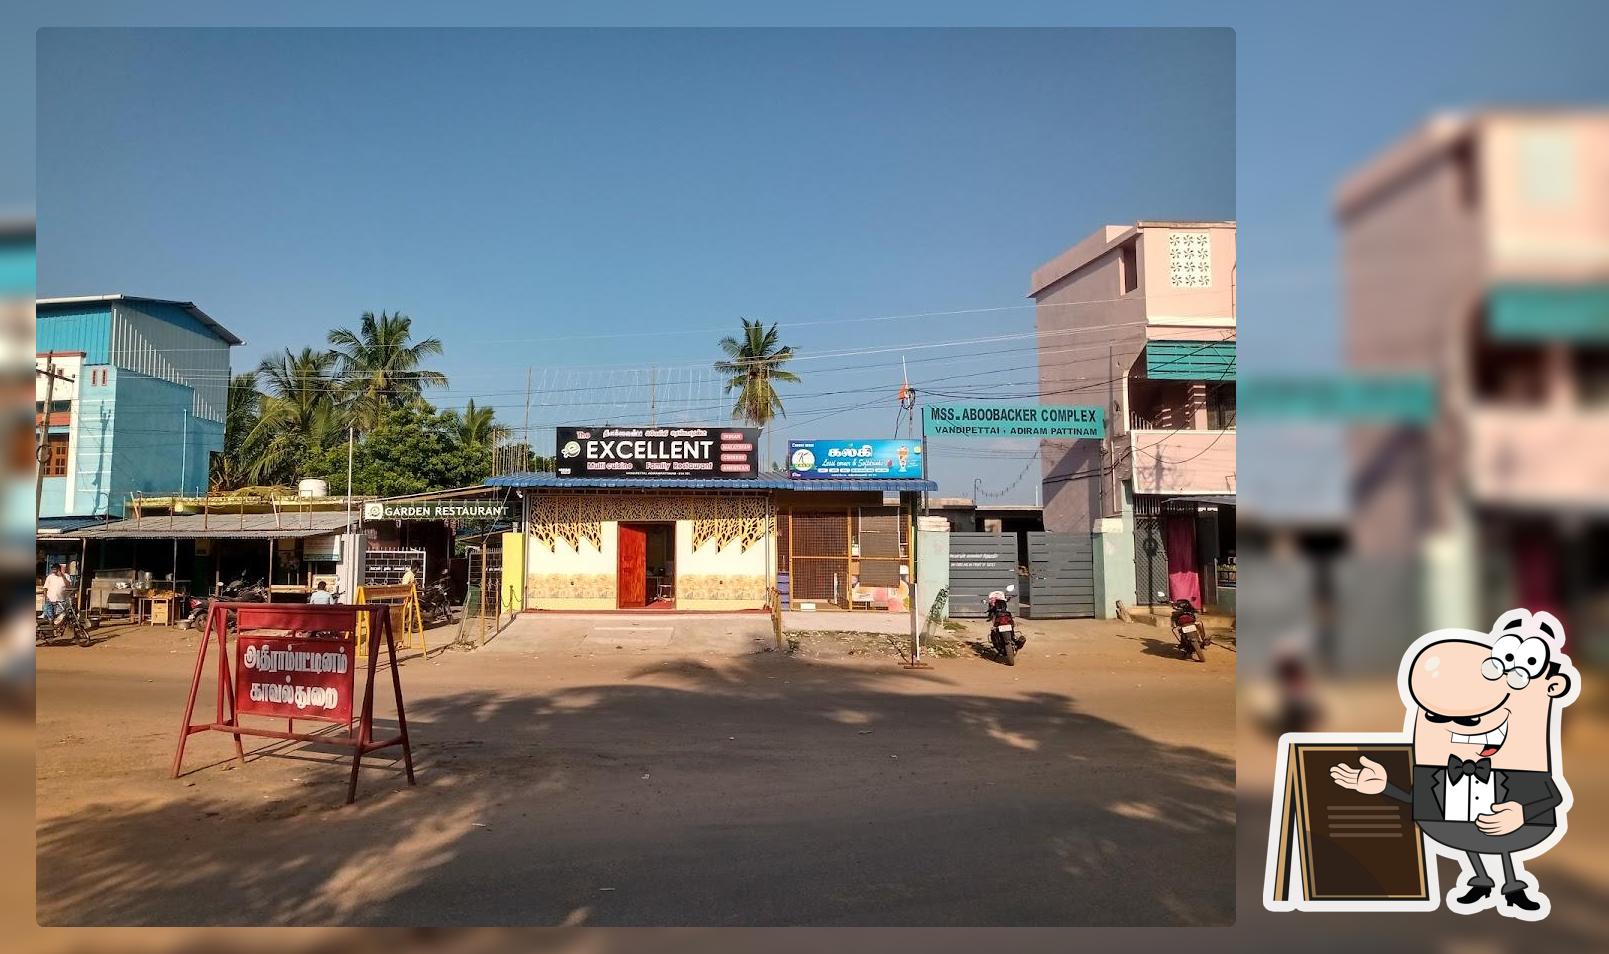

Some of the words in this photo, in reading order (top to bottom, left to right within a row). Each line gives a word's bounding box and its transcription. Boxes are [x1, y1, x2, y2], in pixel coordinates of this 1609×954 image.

[962, 408, 1037, 422] ABOOBACKER
[1041, 409, 1096, 423] COMPLEX
[576, 430, 592, 440] The
[935, 426, 1000, 434] VANDIPETTAI
[1010, 427, 1048, 435] ADIRAM
[1051, 427, 1098, 436] PATTINAM
[586, 440, 714, 460] EXCELLENT
[606, 462, 634, 470] cuisine
[645, 461, 672, 471] Family
[672, 461, 713, 470] Restaurant
[384, 506, 431, 517] GARDEN
[434, 506, 509, 517] RESTAURANT
[249, 674, 339, 710] காவல்துறை
